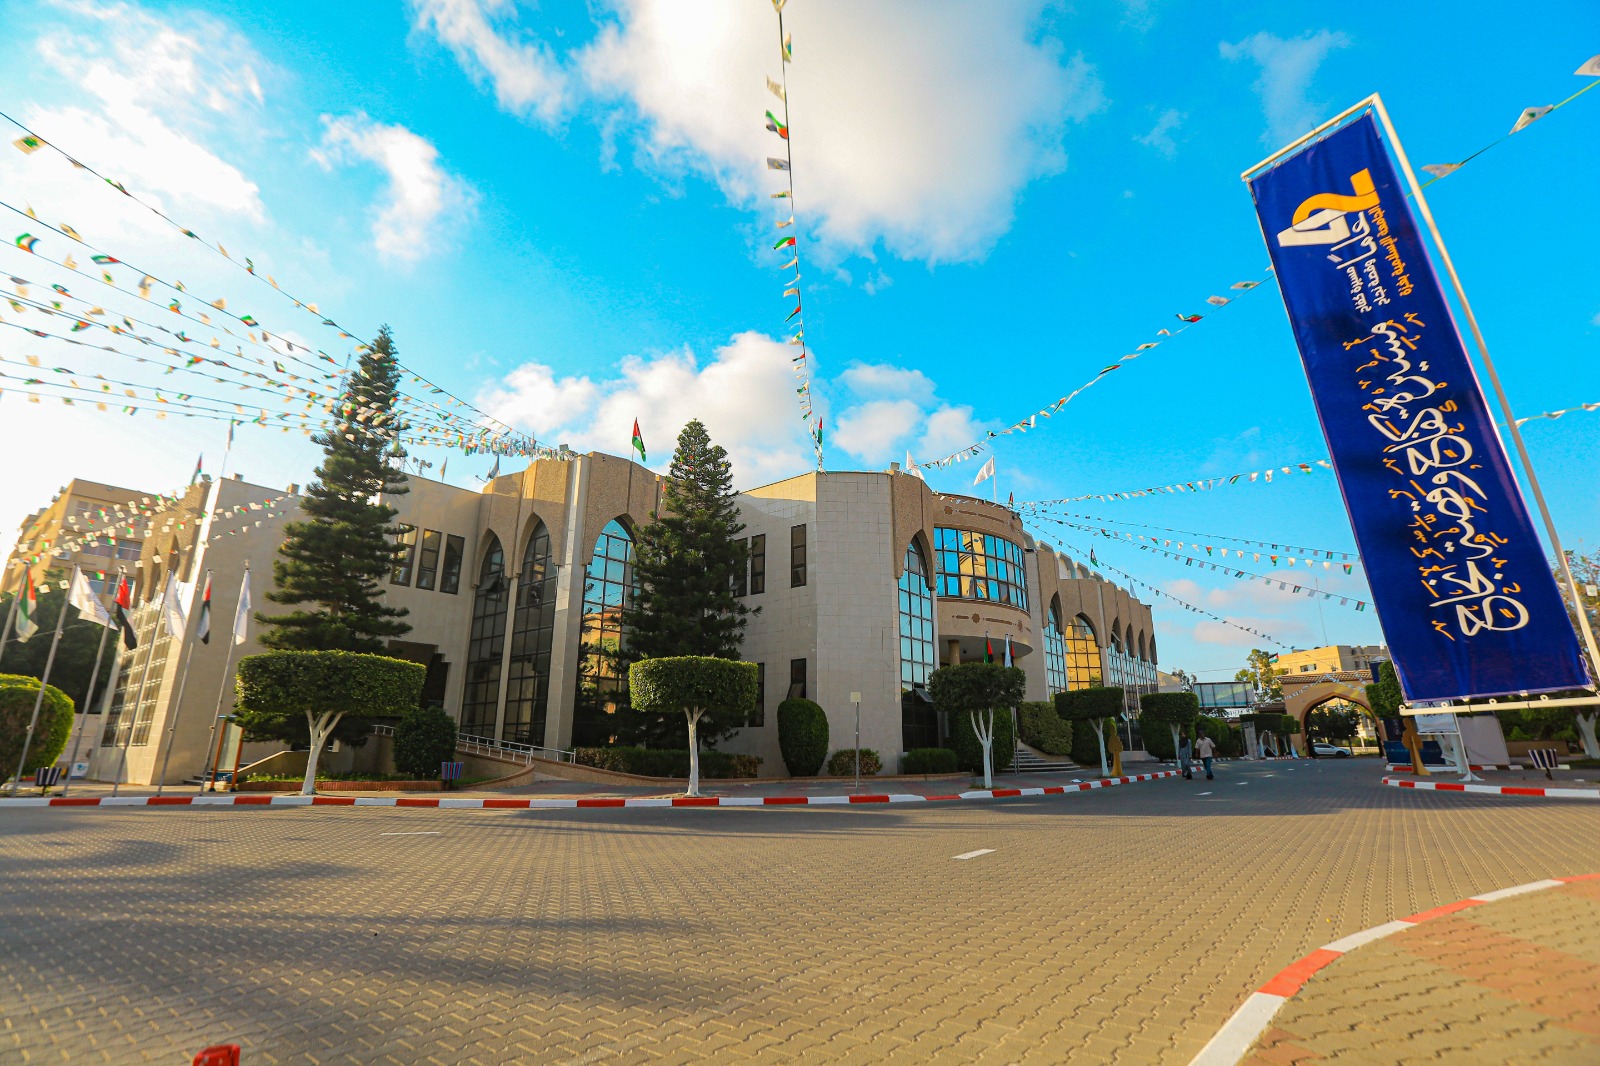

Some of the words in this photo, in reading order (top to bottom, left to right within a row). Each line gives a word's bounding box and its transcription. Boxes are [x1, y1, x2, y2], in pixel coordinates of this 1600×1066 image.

[1277, 168, 1380, 247] 42
[1368, 205, 1389, 237] الجامعة
[1396, 274, 1413, 296] بغزة
[1347, 266, 1363, 294] مسيرة
[1364, 259, 1379, 287] وقصة
[1352, 293, 1372, 312] كفاح
[1371, 286, 1390, 305] نجاح
